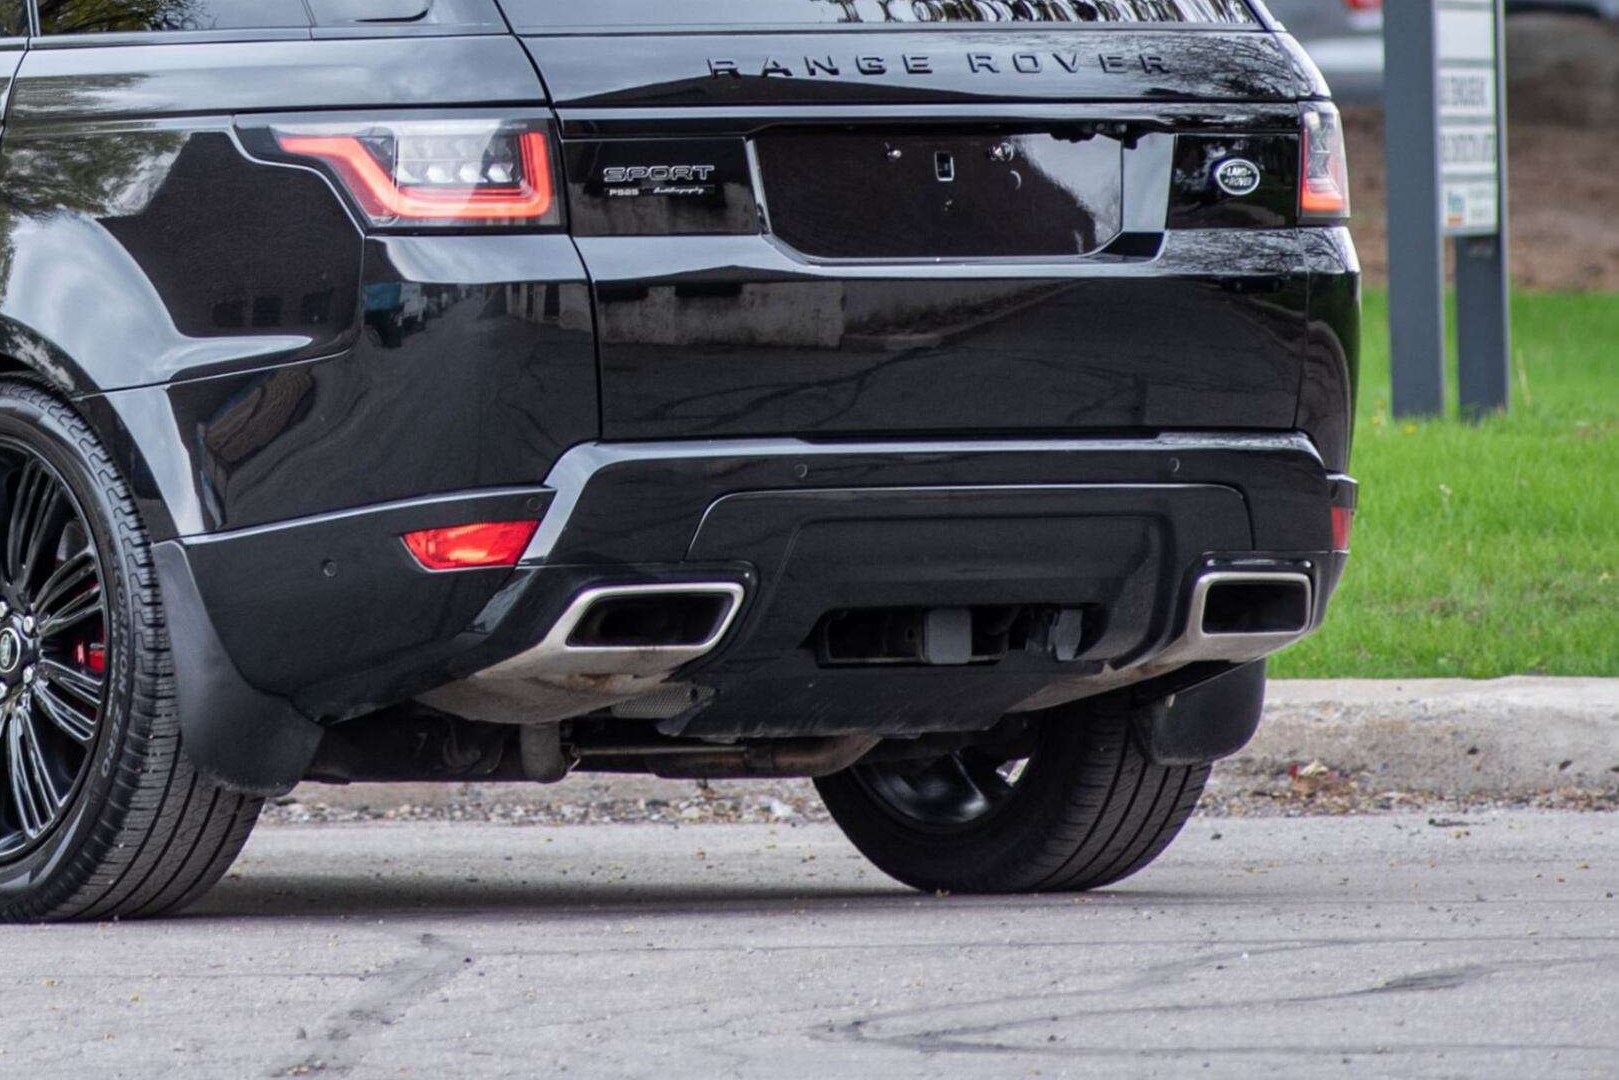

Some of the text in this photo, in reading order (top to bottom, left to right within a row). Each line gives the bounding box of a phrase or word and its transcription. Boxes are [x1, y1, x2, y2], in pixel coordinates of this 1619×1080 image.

[706, 52, 1172, 80] RANGE ROVER
[603, 165, 715, 183] SPORT
[101, 703, 122, 777] ZERO
